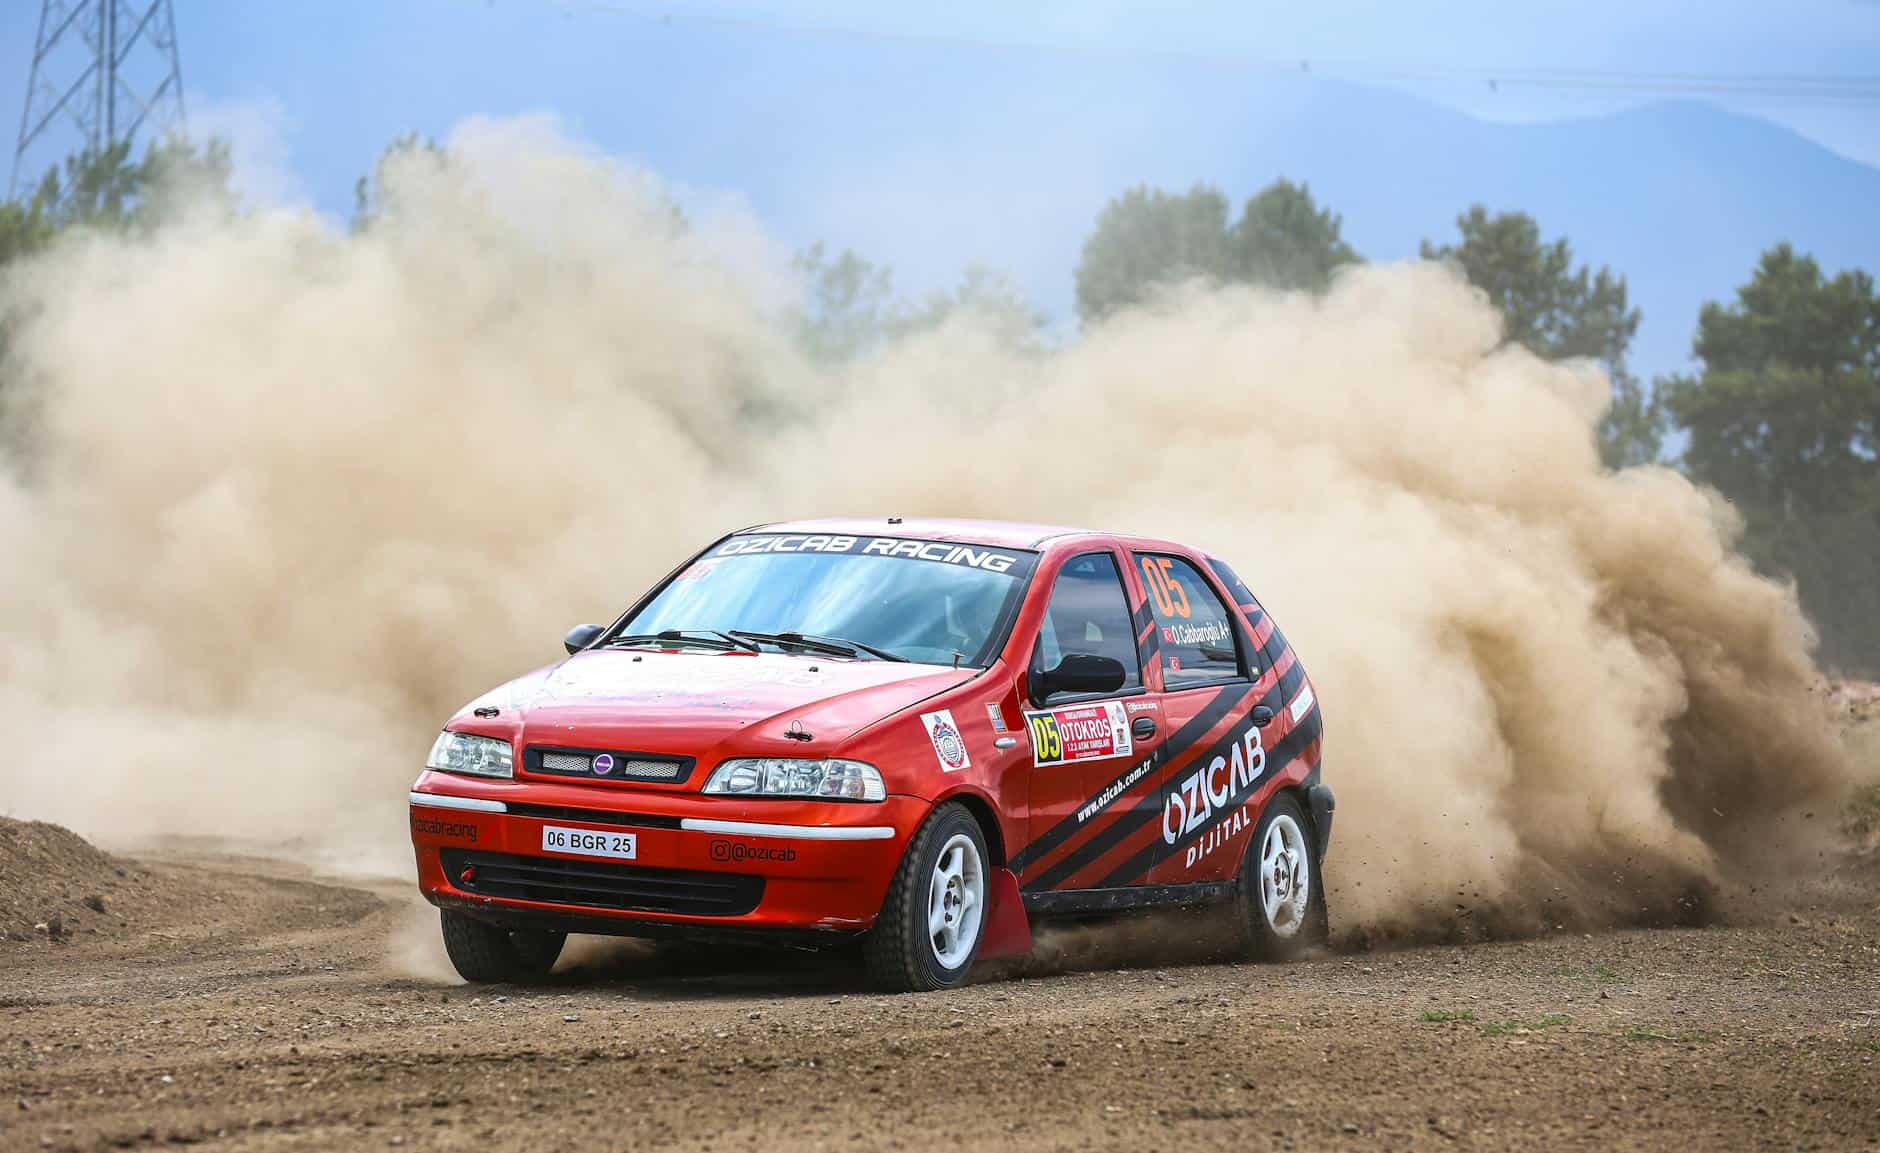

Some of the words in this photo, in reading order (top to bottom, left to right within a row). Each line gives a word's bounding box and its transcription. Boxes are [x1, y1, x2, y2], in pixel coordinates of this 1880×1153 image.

[716, 534, 856, 557] OZICAB
[862, 538, 1017, 574] RACING
[1141, 557, 1191, 618] 05
[1032, 716, 1061, 759] 05
[1060, 718, 1112, 743] OTOKROS
[1077, 758, 1152, 824] www.ozicab.com.tr
[1162, 725, 1267, 845] OZICAB
[547, 831, 566, 847] 06
[570, 834, 607, 851] BGR
[612, 838, 632, 853] 25
[732, 842, 797, 862] @ozicab
